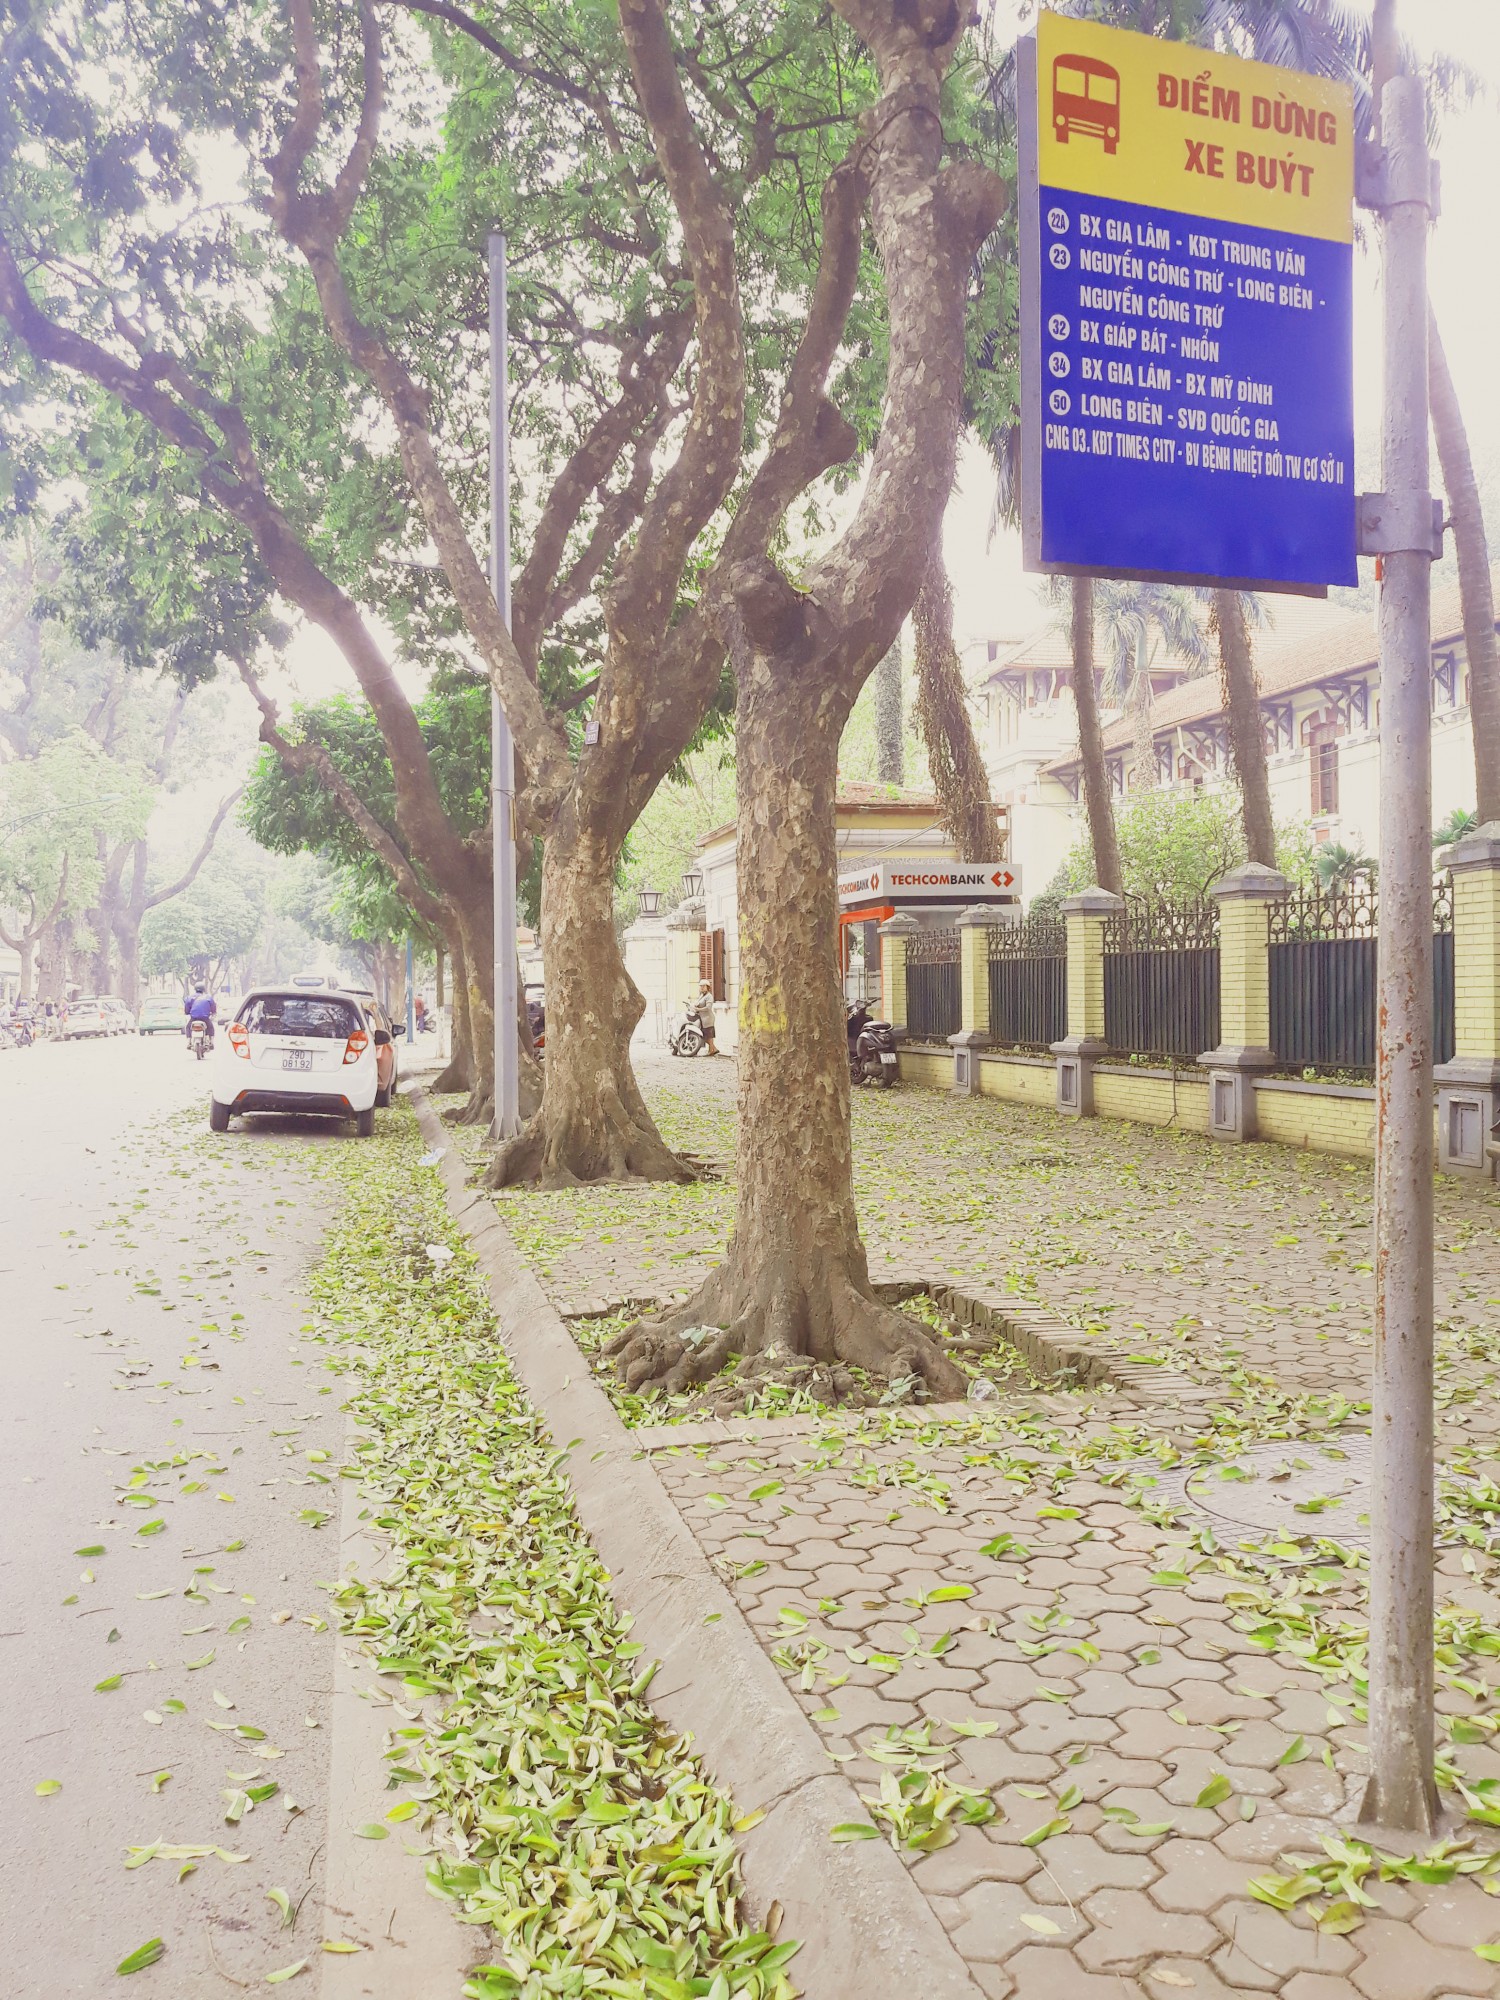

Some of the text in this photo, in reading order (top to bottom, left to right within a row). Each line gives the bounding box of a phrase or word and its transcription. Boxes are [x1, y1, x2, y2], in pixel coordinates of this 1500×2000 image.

[1157, 70, 1336, 146] ĐIỂM DỪNG
[1184, 138, 1314, 197] XE BUÝT
[1051, 212, 1066, 230] 22A
[1080, 214, 1101, 238] BX
[1106, 219, 1132, 244] GIA
[1137, 222, 1170, 250] LÂM
[1188, 234, 1217, 259] KĐT
[1222, 240, 1271, 270] TRUNG
[1275, 248, 1305, 276] VĂN
[1053, 249, 1067, 265] 23
[1080, 249, 1143, 280] NGUYỄN
[1148, 258, 1189, 288] CÔNG
[1194, 268, 1224, 294] TRỨ
[1237, 277, 1275, 303] LONG
[1279, 283, 1312, 310] BIÊN
[1080, 285, 1225, 329] NGUYỄN CÔNG TRỨ
[1053, 319, 1066, 336] 32
[1080, 320, 1099, 344] BX
[1104, 321, 1137, 349] GIÁP
[1141, 327, 1167, 354] BÁT
[1181, 329, 1219, 363] NHỔN
[1053, 357, 1066, 373] 34
[1082, 357, 1103, 381] BX
[1108, 362, 1134, 386] GIA
[1138, 362, 1171, 391] LÂM
[1186, 373, 1206, 396] BX
[1211, 375, 1233, 401] MỸ
[1238, 377, 1273, 405] ĐÌNH
[1054, 395, 1067, 411] 50
[1081, 394, 1122, 420] LONG
[1127, 397, 1163, 426] BIÊN
[1177, 408, 1207, 431] SVĐ
[1211, 407, 1250, 438] QUỐC
[1254, 419, 1279, 442] GIA
[1045, 424, 1069, 450] CNG
[1072, 427, 1090, 453] 03.
[1092, 430, 1113, 456] KĐT
[1115, 433, 1150, 461] TIMES
[1153, 437, 1176, 464] CITY
[1186, 442, 1200, 466] BV
[1202, 440, 1230, 473] BỆNH
[1233, 445, 1263, 478] NHIỆT
[1265, 449, 1283, 477] ĐỚI
[1285, 454, 1301, 479] TW
[1304, 457, 1319, 482] CƠ
[1320, 453, 1335, 483] SỞ
[891, 874, 985, 886] TECHCOMBANK
[289, 1050, 305, 1060] 29D
